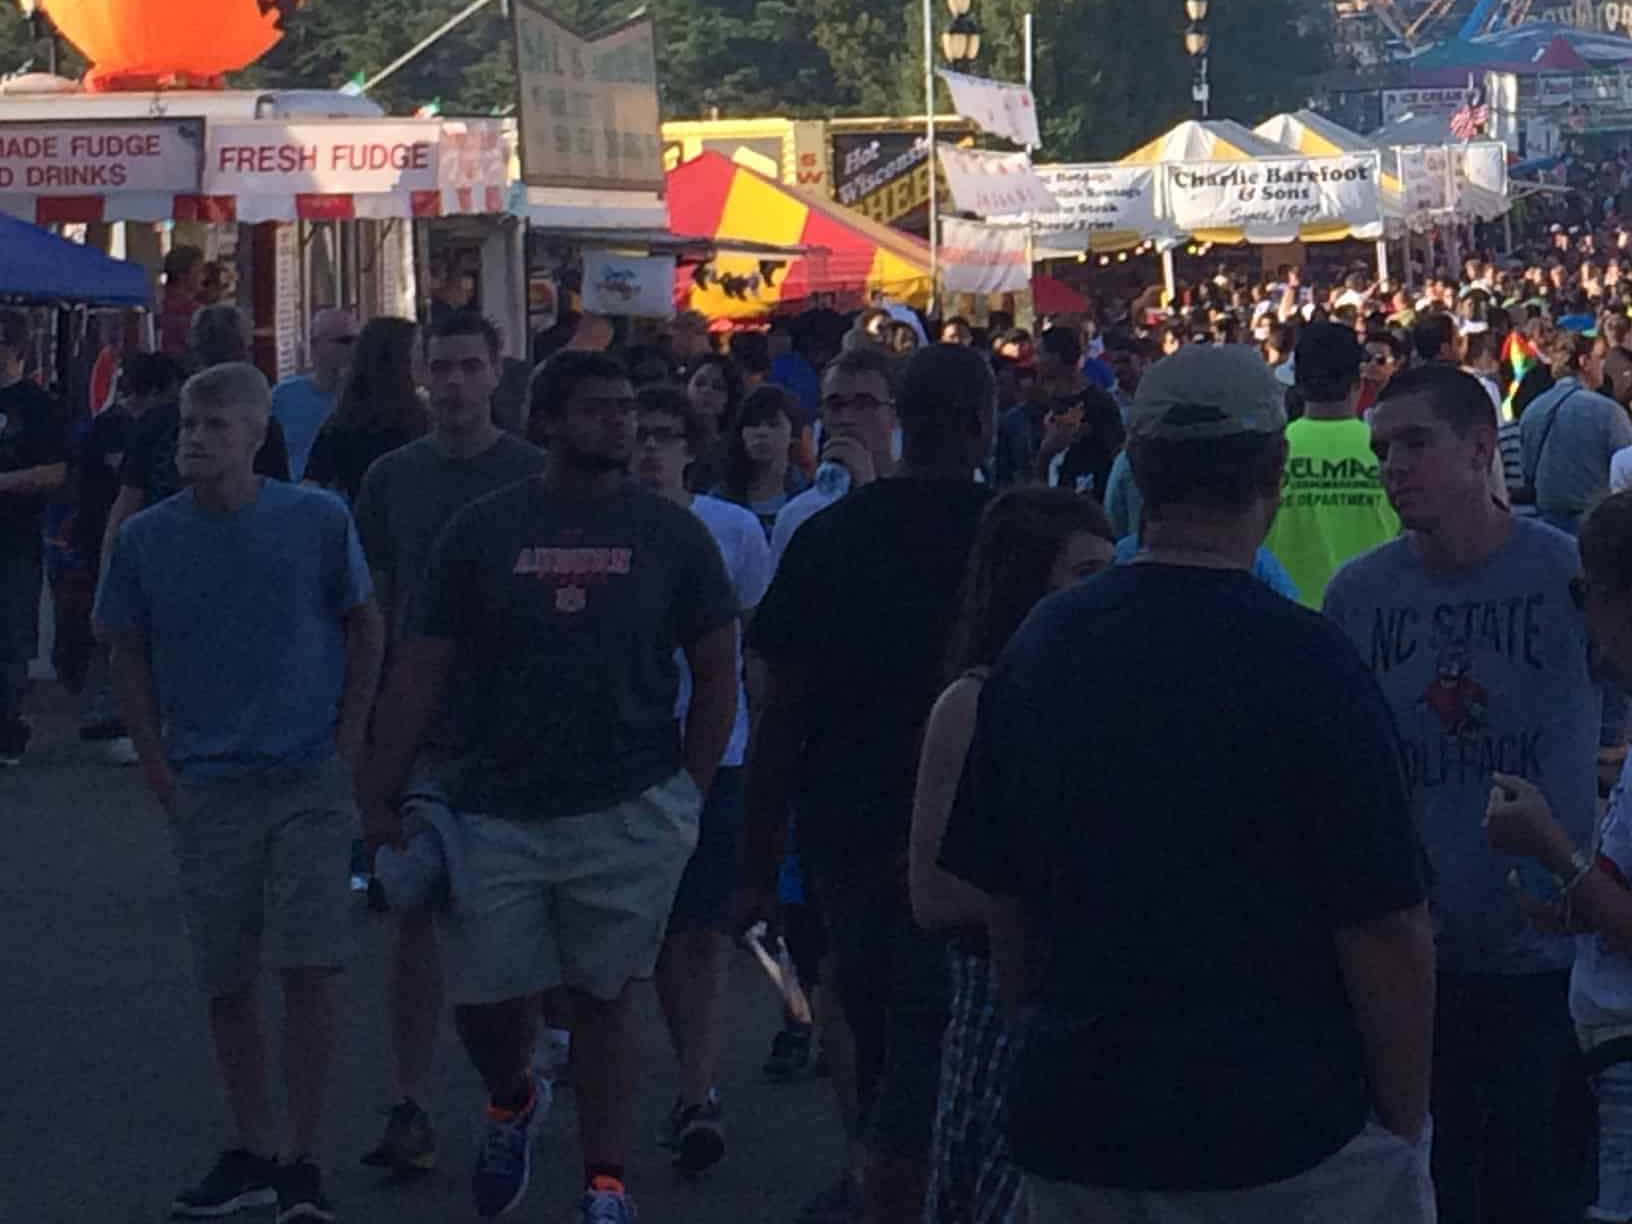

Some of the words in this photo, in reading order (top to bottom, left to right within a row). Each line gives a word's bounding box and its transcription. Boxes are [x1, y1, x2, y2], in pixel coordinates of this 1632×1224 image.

[0, 135, 58, 159] ADE
[70, 133, 162, 158] FUDGE
[218, 144, 317, 173] FRESH
[331, 143, 430, 171] FUDGE
[26, 162, 128, 187] DRINKS
[1173, 167, 1259, 188] Charlie
[1265, 164, 1370, 184] Barefoot
[1261, 185, 1311, 201] Sons
[1371, 607, 1419, 672] NC
[1430, 592, 1543, 670] STATE
[1400, 722, 1544, 798] OLFPACK
